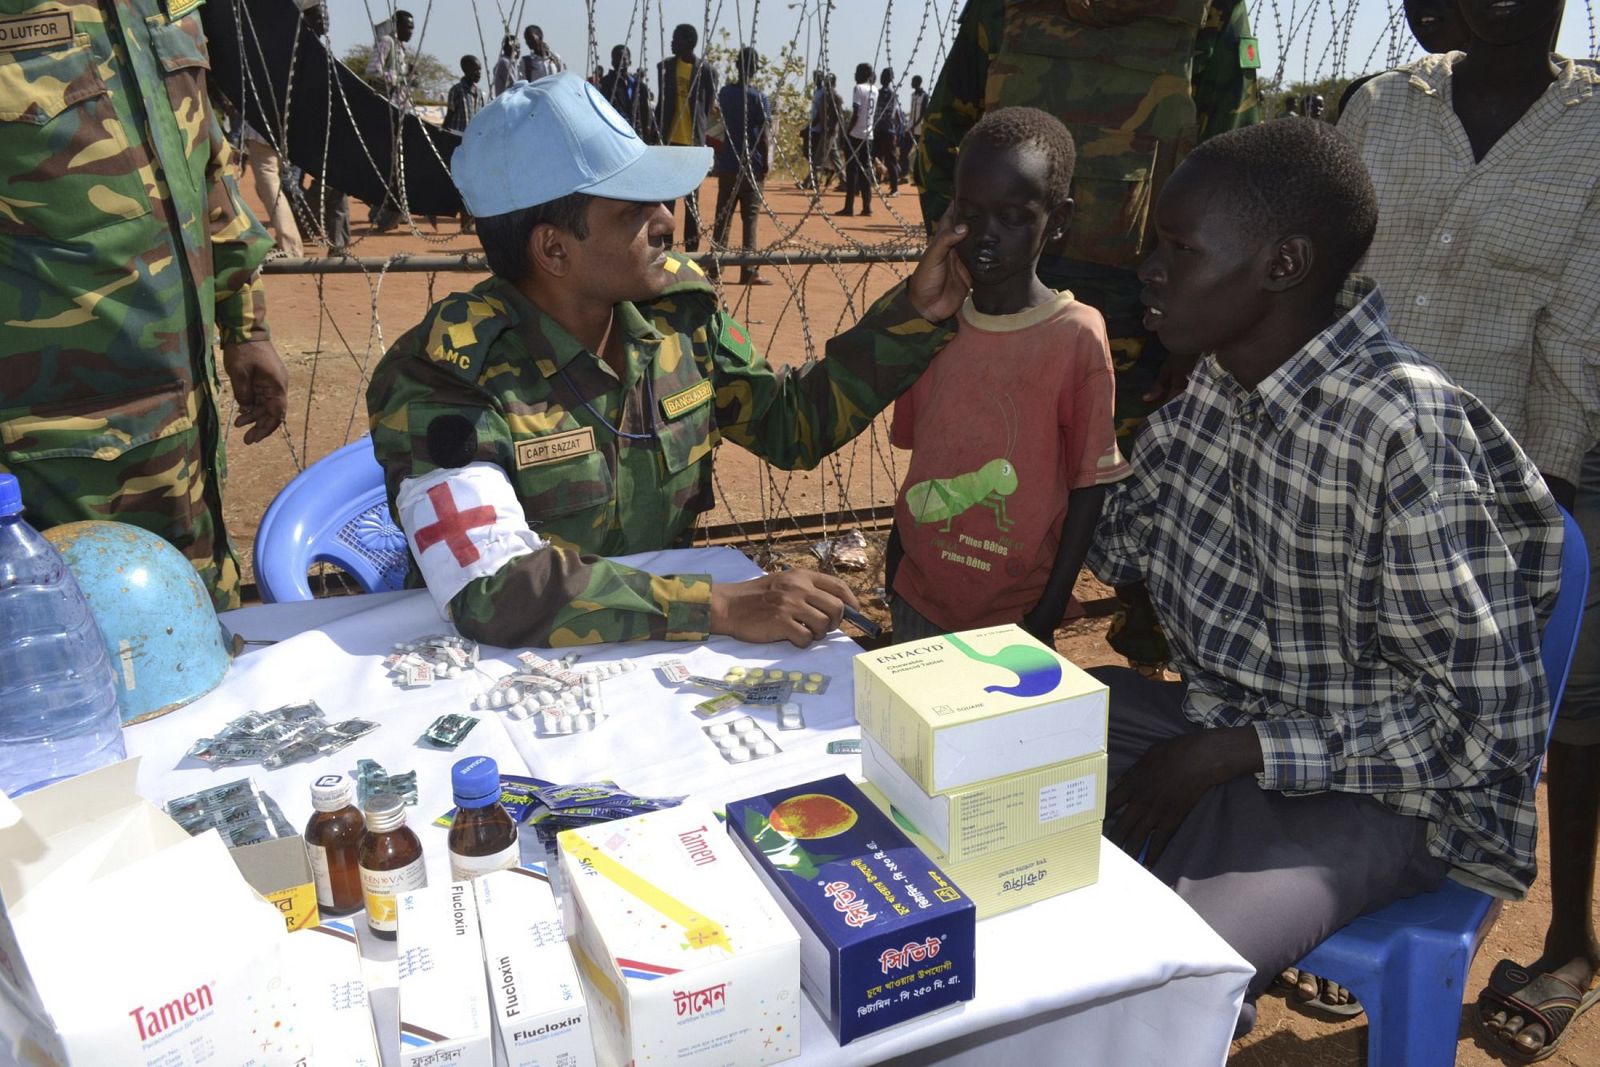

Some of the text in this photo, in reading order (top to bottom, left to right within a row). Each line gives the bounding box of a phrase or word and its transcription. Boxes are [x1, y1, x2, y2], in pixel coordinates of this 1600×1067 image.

[11, 22, 58, 40] LUTFOR
[434, 345, 471, 370] AMC
[526, 438, 580, 459] CAPT SAZZAT
[876, 643, 944, 664] ENTACYD
[678, 826, 717, 867] Tamen
[451, 885, 469, 936] Flucloxin
[824, 880, 877, 928] সিভিট
[880, 937, 942, 975] সিভিট
[498, 955, 520, 1018] Flucloxin
[673, 982, 727, 1016] টামেন
[857, 997, 891, 1018] ভিটামিন
[913, 985, 932, 997] ২৫০
[128, 982, 214, 1041] Tamen
[513, 1016, 582, 1042] Flucloxin
